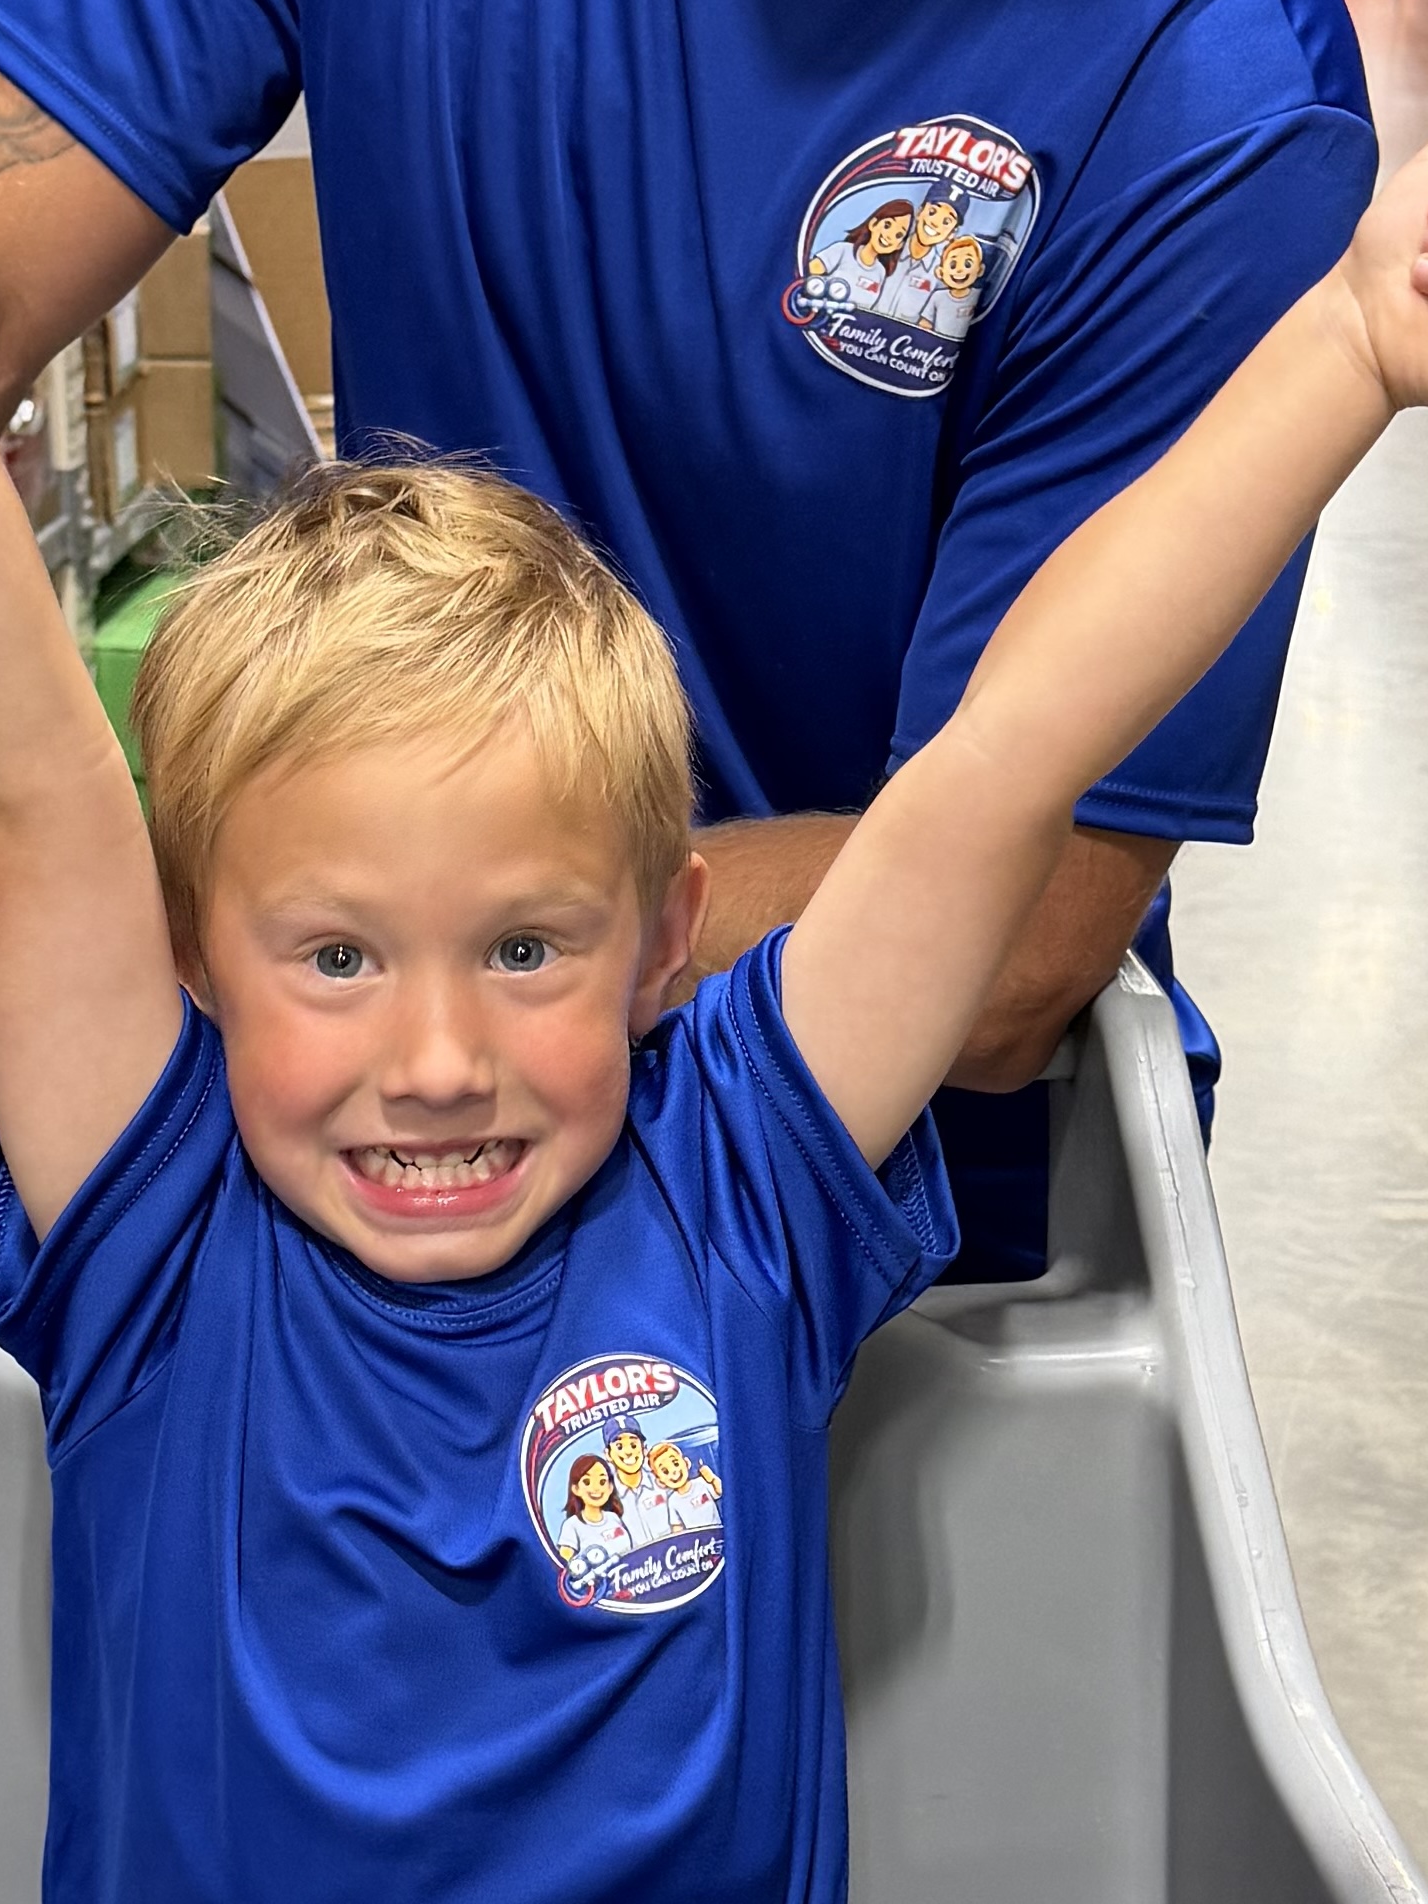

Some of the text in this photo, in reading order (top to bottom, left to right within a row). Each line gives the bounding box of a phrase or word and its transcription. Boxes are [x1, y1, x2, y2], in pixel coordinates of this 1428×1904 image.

[892, 127, 1032, 190] TAYLOR'S
[909, 158, 1000, 197] TRUSTED AIR
[827, 312, 960, 375] Family Comfort
[840, 341, 862, 357] YOU
[864, 348, 888, 367] CAN
[889, 356, 930, 382] COUNT
[535, 1363, 678, 1433] TAYLOR'S
[561, 1394, 661, 1435] TRUSTED AIR
[610, 1538, 718, 1593] Family Comfort
[628, 1581, 650, 1597] YOU
[651, 1574, 671, 1589] CAN
